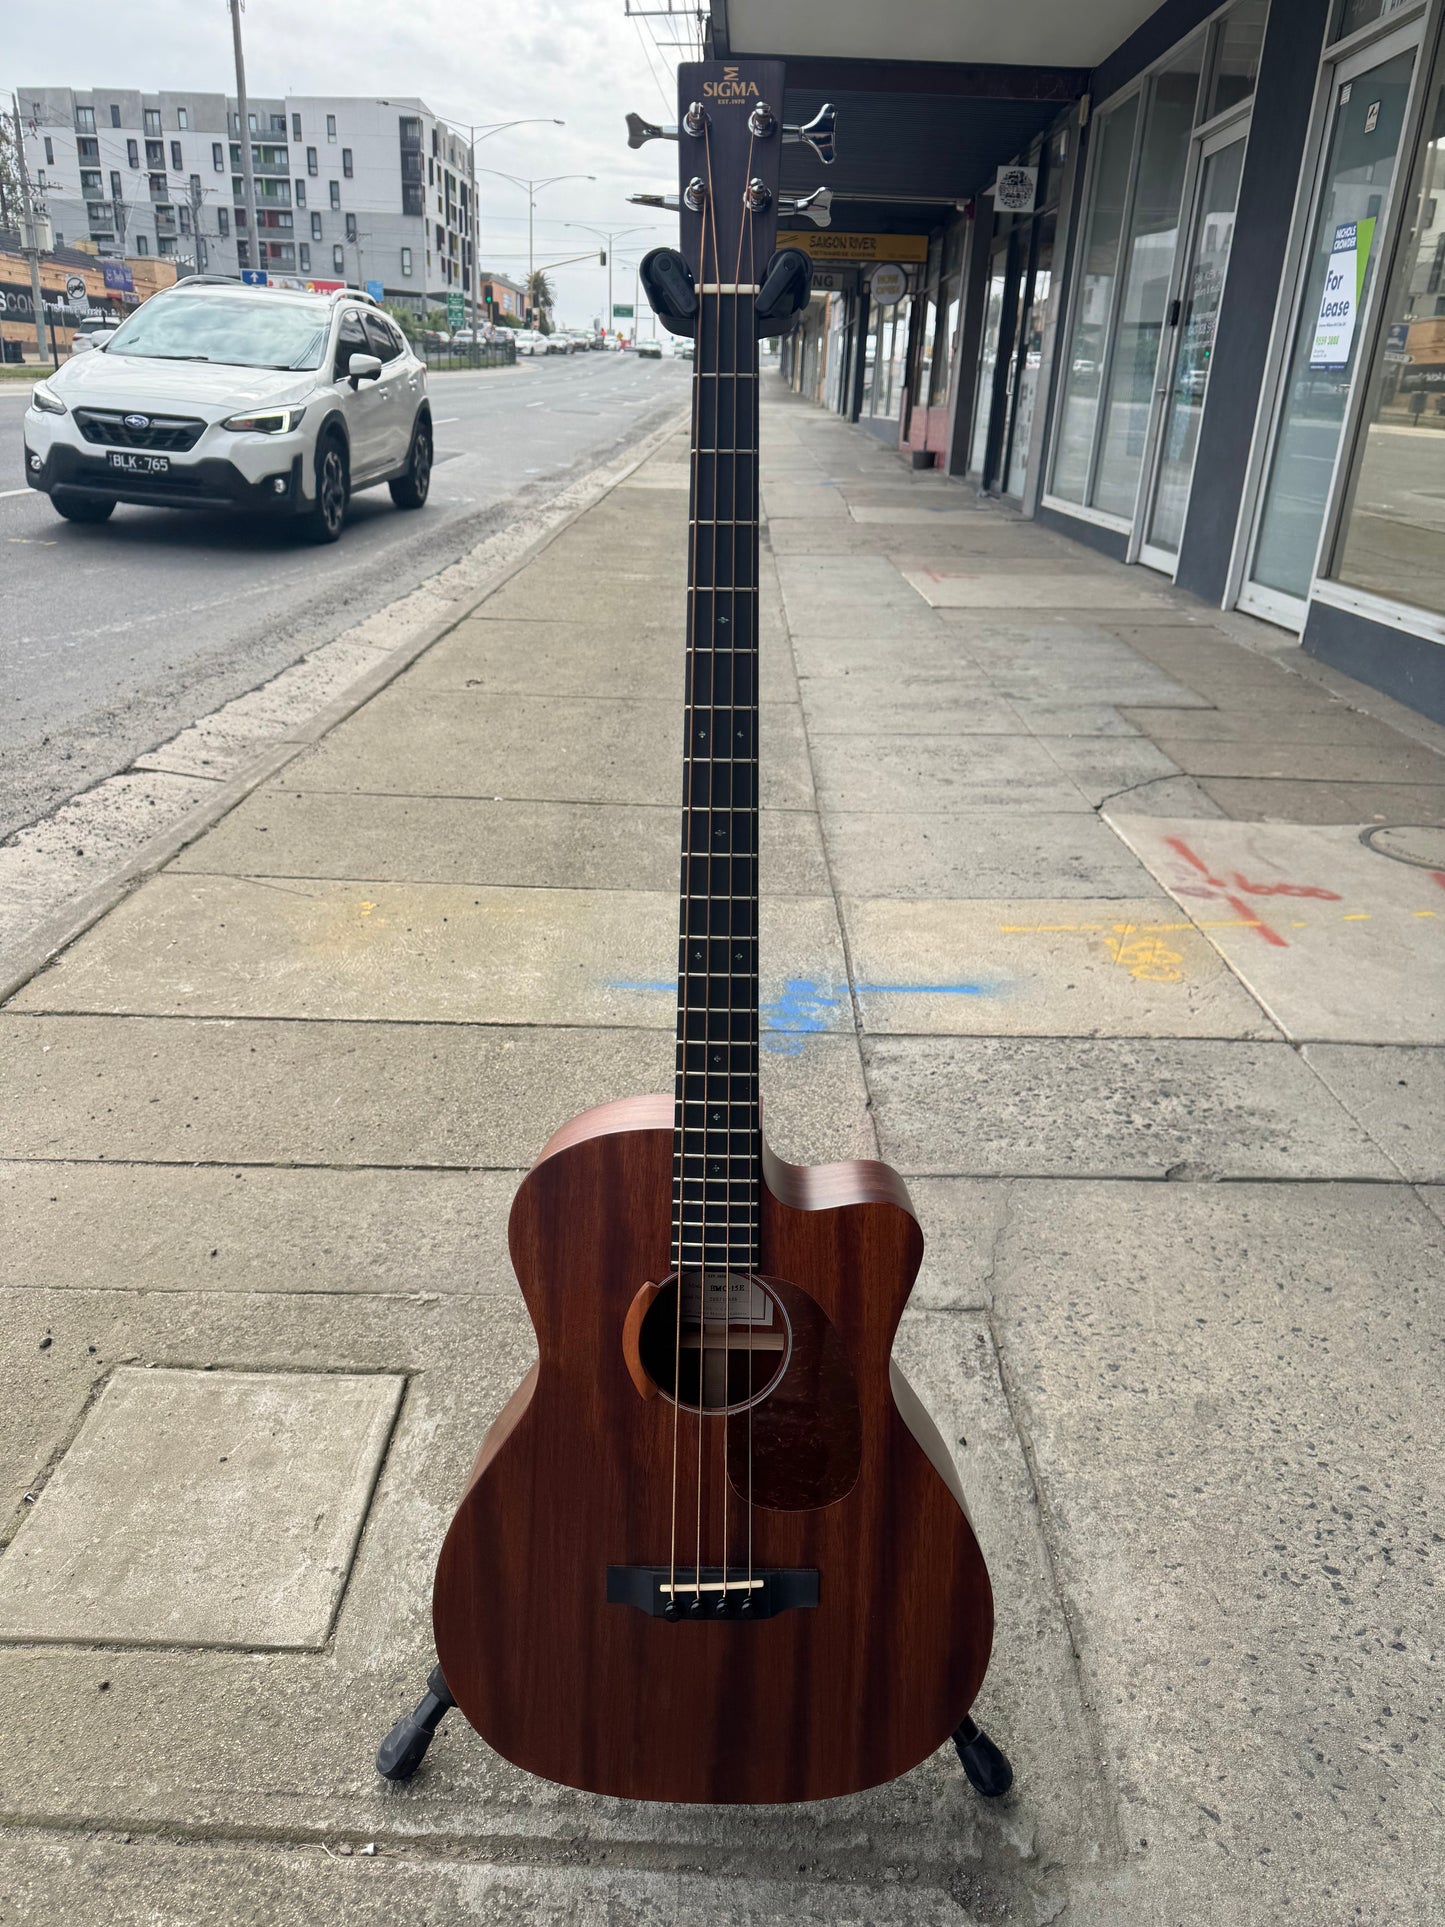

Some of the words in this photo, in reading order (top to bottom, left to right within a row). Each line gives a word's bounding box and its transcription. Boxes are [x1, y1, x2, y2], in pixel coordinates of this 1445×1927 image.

[703, 82, 759, 97] SIGMA
[1336, 225, 1356, 239] NICHOLS
[809, 235, 846, 249] SAIGON
[848, 237, 877, 250] RIVER
[1333, 239, 1356, 250] CROWDER
[1326, 270, 1344, 291] For
[1320, 298, 1350, 318] Lease
